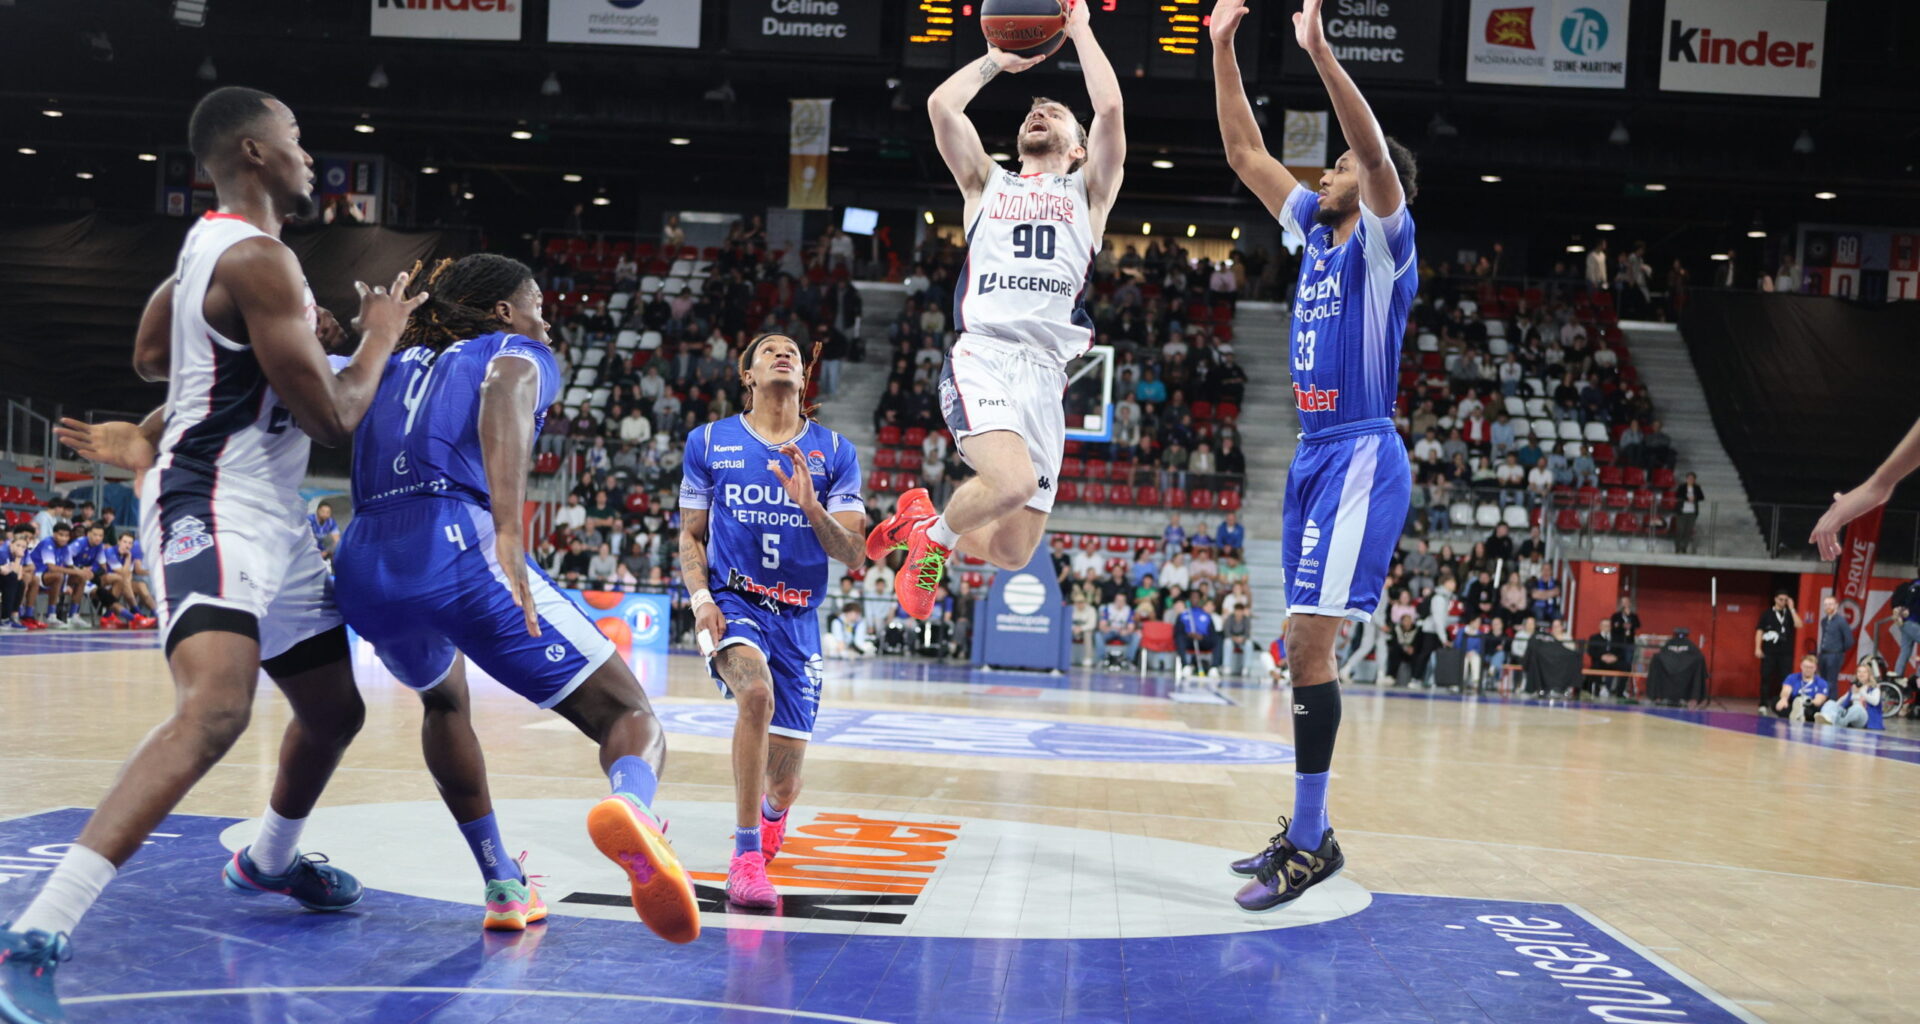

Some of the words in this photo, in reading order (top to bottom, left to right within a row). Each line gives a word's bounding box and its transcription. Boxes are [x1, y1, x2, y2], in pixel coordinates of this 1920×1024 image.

[588, 13, 659, 27] métropole
[1338, 0, 1389, 17] Salle
[762, 17, 847, 38] Dumerc
[986, 25, 1046, 41] SPALDING
[1327, 19, 1397, 40] Céline
[1566, 12, 1600, 56] 76
[1474, 55, 1545, 67] NORMANDIE
[1553, 60, 1624, 74] SEINE-MARITIME
[989, 192, 1074, 224] NANTES
[1013, 224, 1056, 260] 90
[999, 275, 1073, 297] LEGENDRE
[1295, 330, 1316, 371] 33
[403, 367, 434, 436] 4
[1293, 382, 1339, 412] inder
[713, 444, 744, 454] Kempa
[712, 459, 745, 470] actual
[444, 523, 468, 551] 4
[762, 533, 781, 570] 5
[1844, 538, 1867, 597] DRIVE
[481, 838, 498, 867] Kempa
[558, 812, 962, 924] Kinder
